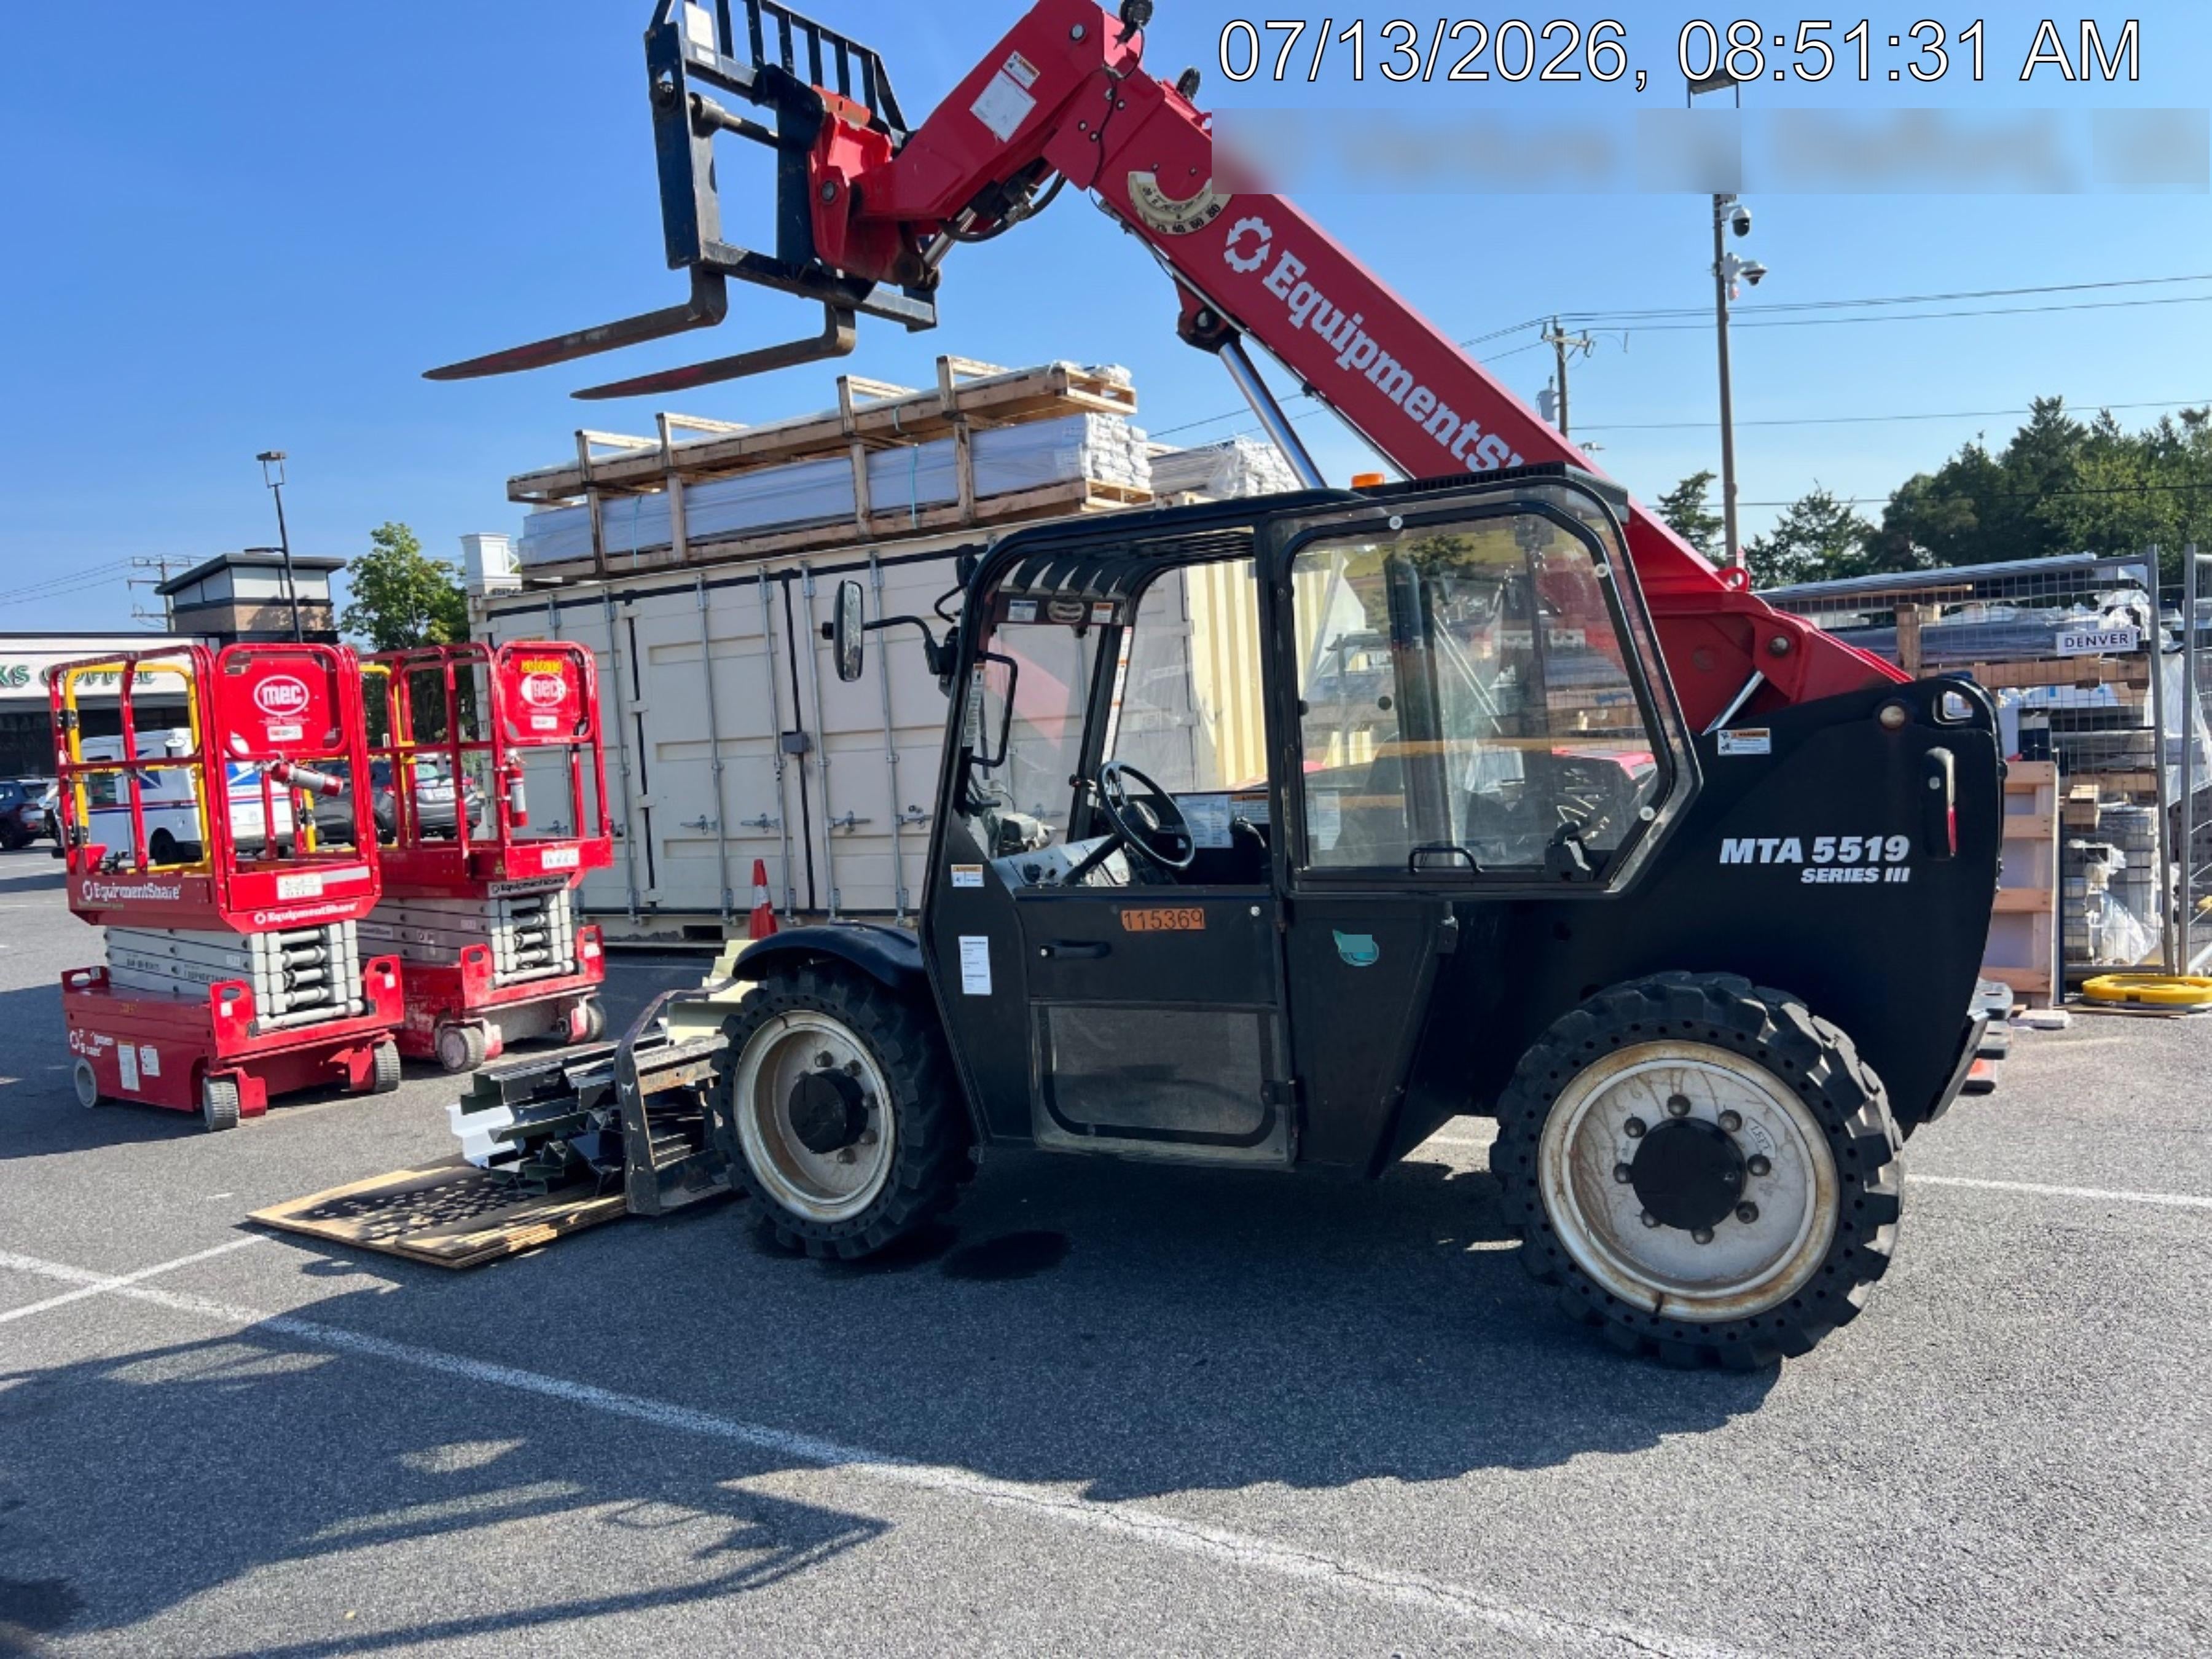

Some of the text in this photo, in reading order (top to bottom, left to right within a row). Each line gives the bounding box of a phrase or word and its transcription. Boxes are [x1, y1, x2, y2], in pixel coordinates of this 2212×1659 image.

[1261, 249, 1524, 473] EquipmentS
[2064, 633, 2129, 648] DENVER
[262, 684, 304, 705] mec
[1719, 835, 1910, 863] MTA 5519
[1800, 867, 1910, 884] SERIES III
[1124, 909, 1203, 930] 115369
[1751, 1125, 1771, 1150] LEFT
